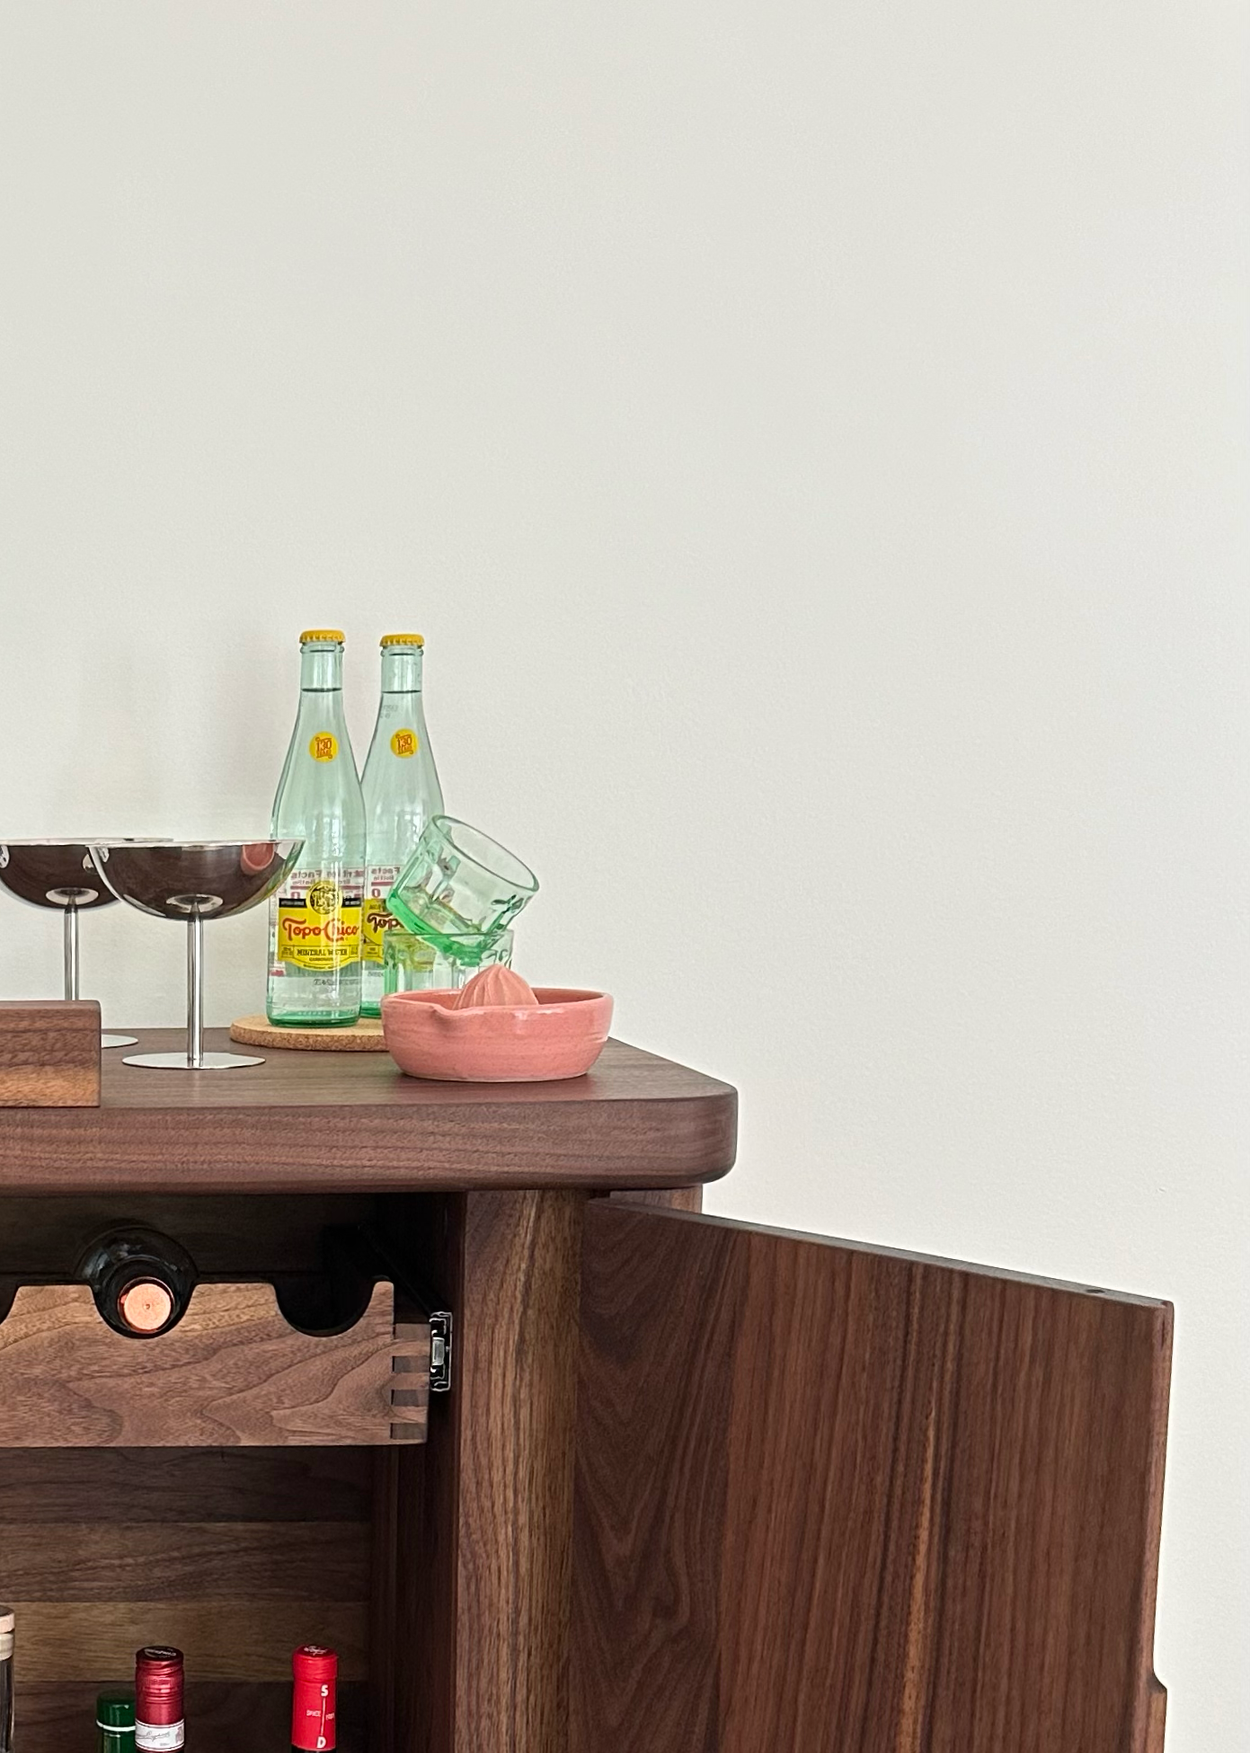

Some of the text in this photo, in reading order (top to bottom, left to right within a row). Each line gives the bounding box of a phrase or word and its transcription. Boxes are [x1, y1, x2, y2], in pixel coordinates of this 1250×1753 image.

[282, 918, 359, 942] Topo Chico
[321, 1684, 329, 1697] S
[317, 1736, 327, 1749] D
